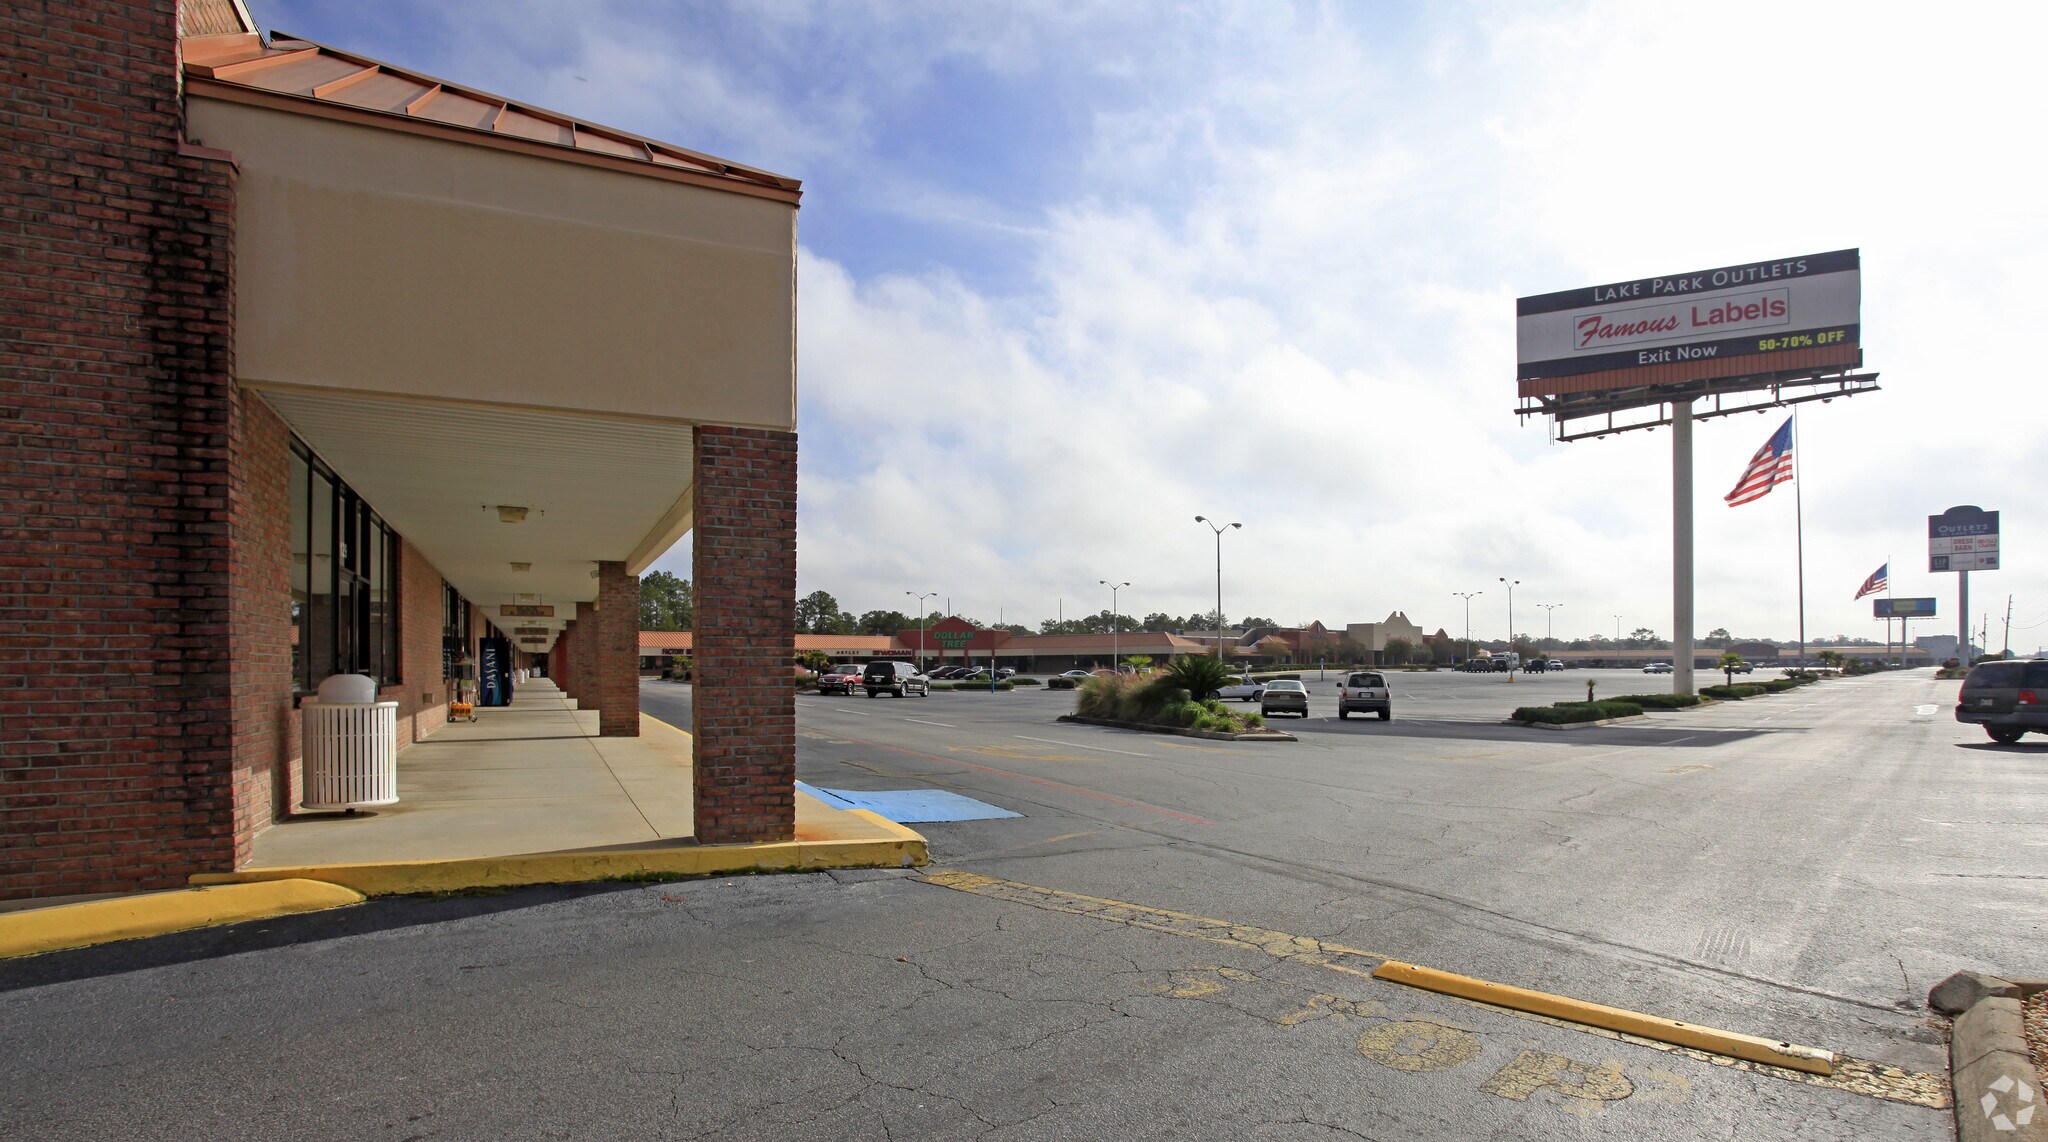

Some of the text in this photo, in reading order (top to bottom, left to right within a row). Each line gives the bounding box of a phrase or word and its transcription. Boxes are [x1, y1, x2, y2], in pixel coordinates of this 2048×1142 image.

[1594, 260, 1808, 302] LAKE PARK OUTLETS
[1577, 297, 1786, 347] Famous Labels
[1759, 330, 1846, 351] 50-70% OFF
[1638, 346, 1718, 364] Exit Now
[933, 631, 975, 640] DOLLAR
[941, 640, 967, 648] TREE
[485, 648, 497, 689] DASANI
